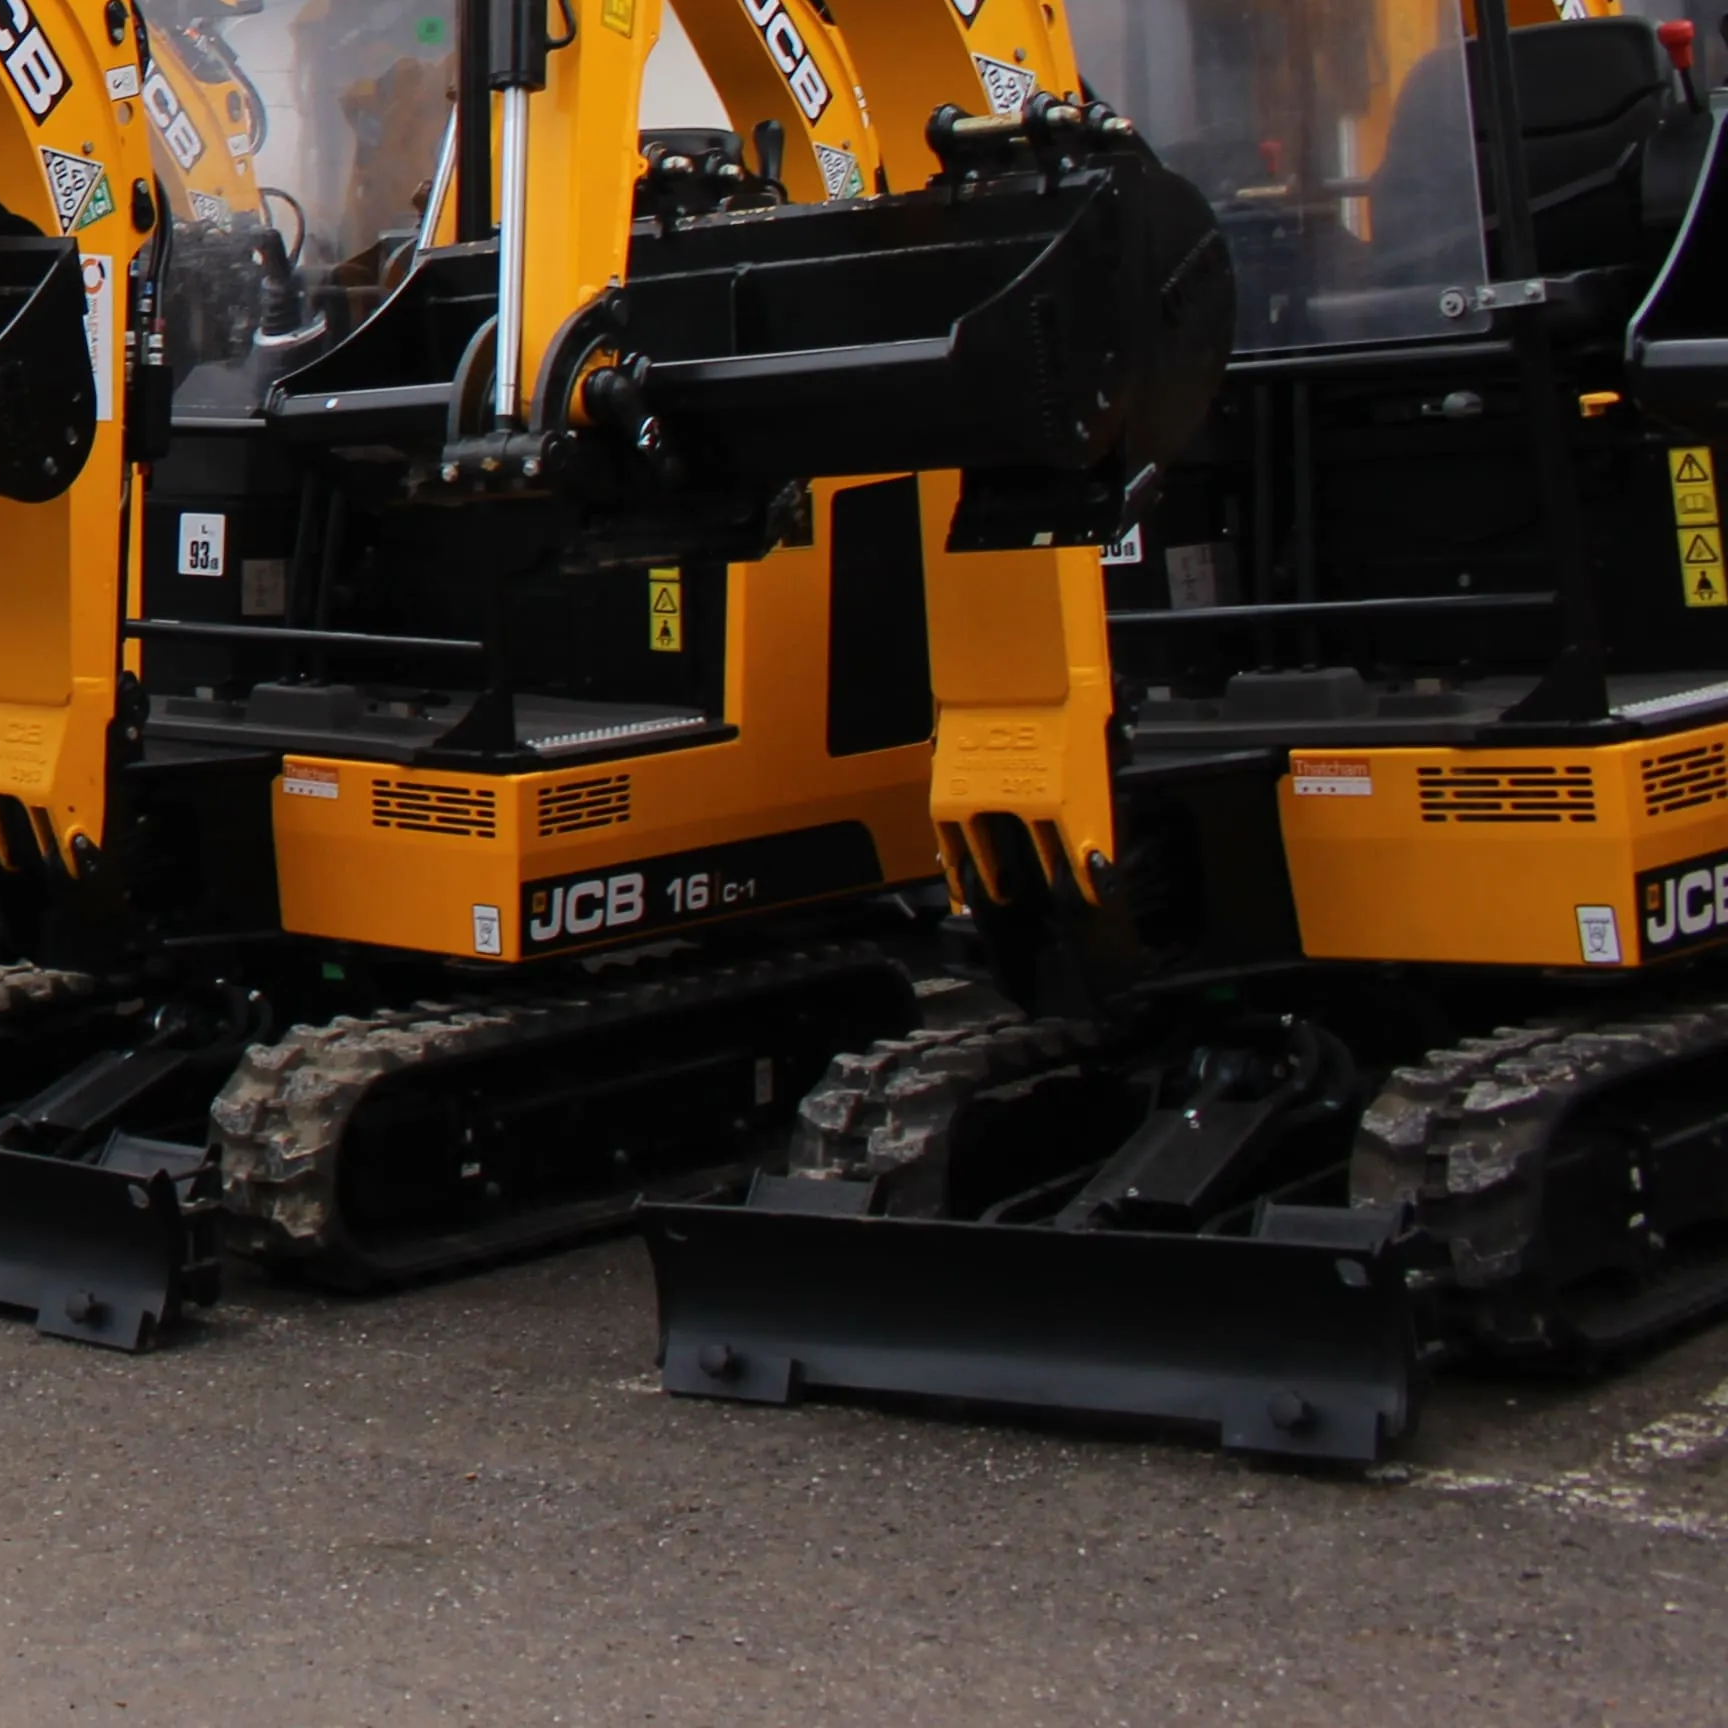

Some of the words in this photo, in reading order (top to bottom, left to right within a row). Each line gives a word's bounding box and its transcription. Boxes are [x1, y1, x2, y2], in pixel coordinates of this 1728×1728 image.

[143, 61, 201, 168] CB
[1294, 759, 1369, 777] Thatcham
[530, 873, 644, 942] JCB
[666, 873, 709, 913] 16
